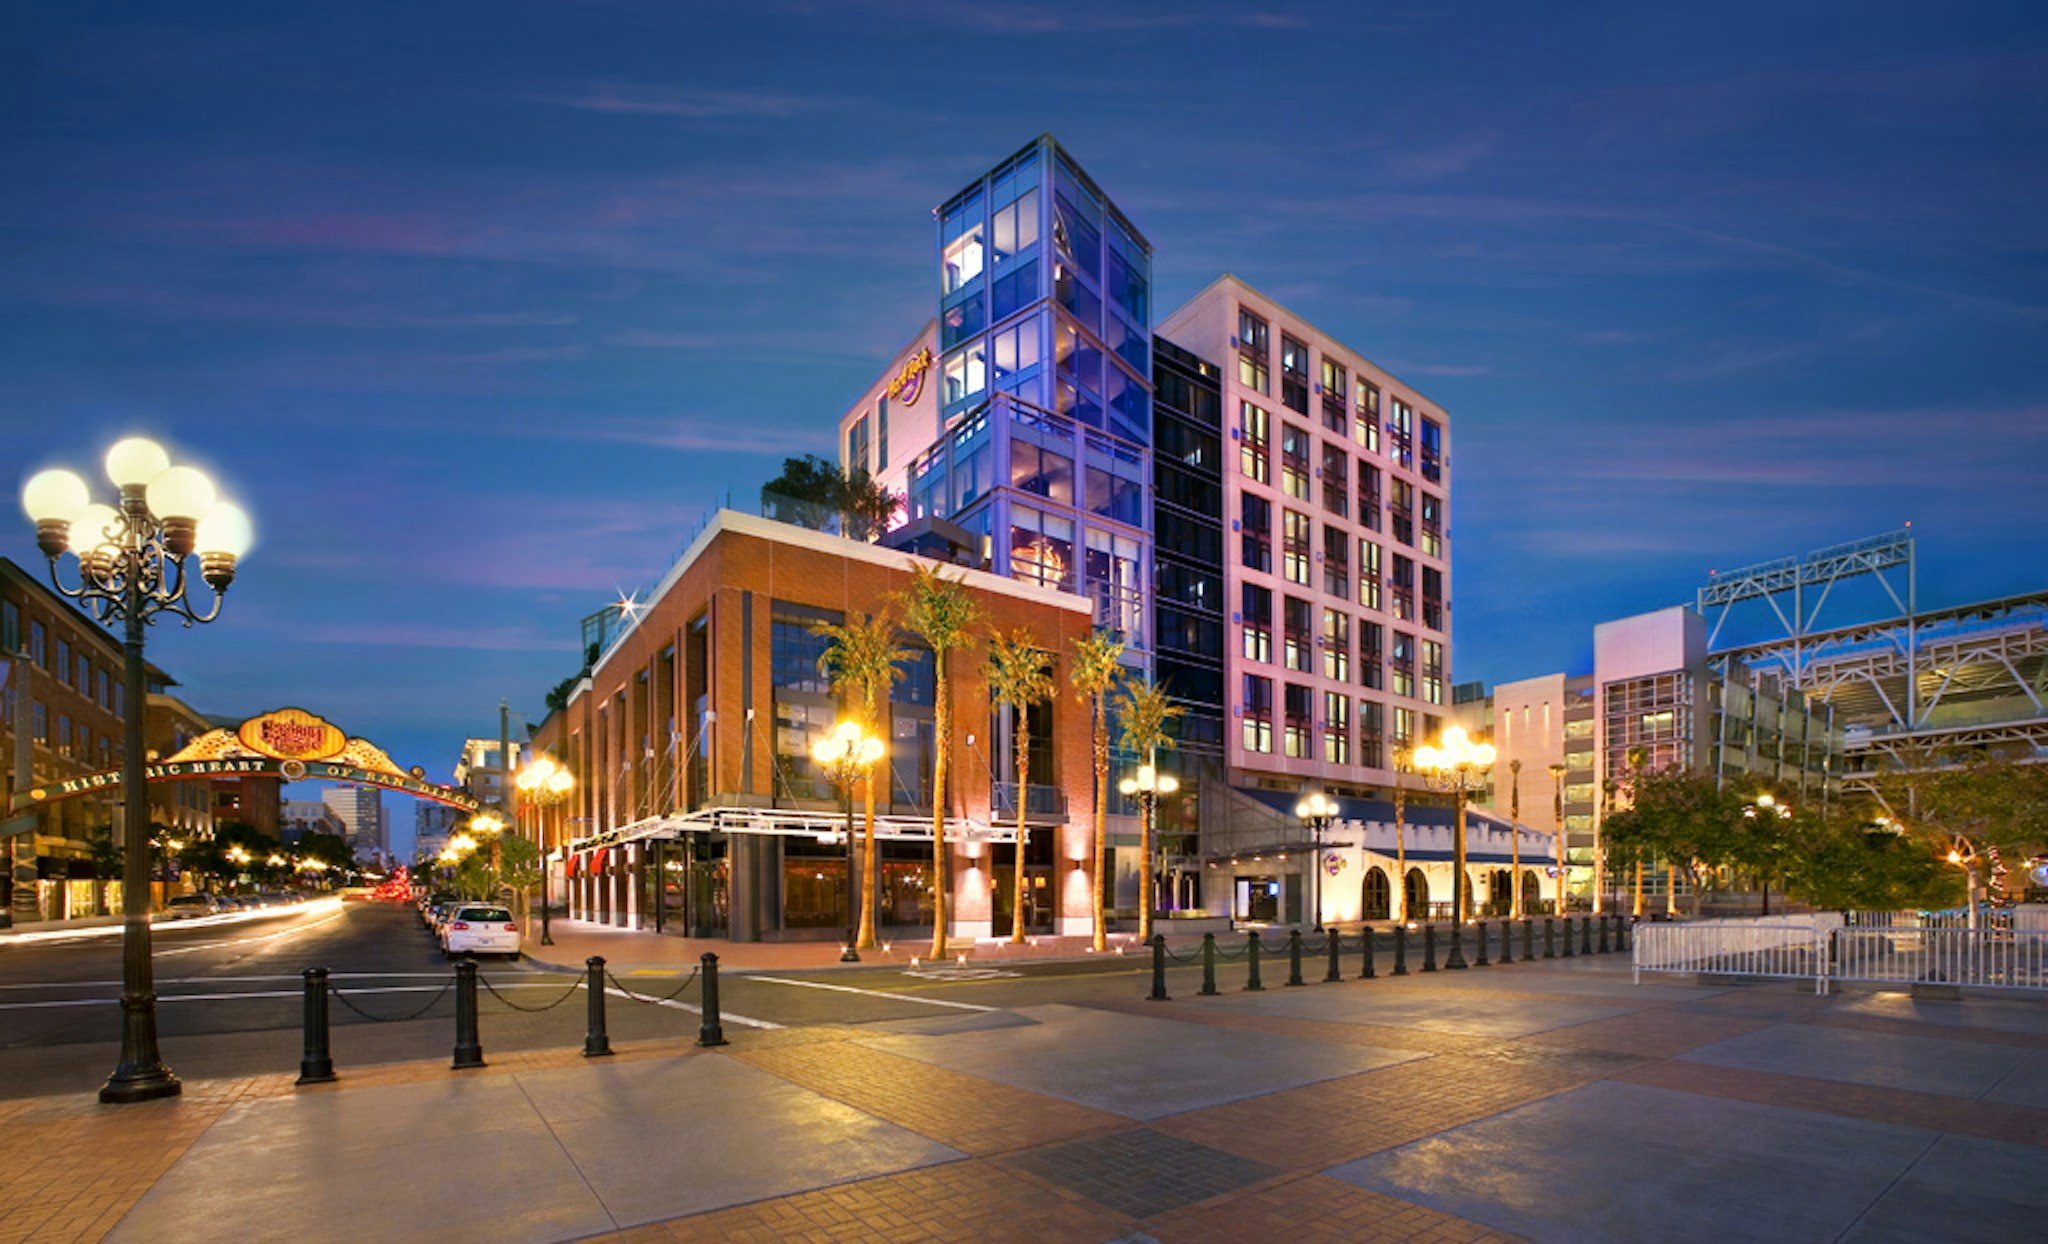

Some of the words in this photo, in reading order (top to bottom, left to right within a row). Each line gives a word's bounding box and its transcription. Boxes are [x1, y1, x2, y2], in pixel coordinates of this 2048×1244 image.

[62, 763, 181, 793] HISTRIC
[192, 760, 265, 773] HEART
[327, 765, 353, 777] OF
[366, 771, 404, 787] SAN
[419, 783, 479, 810] DIEGO
